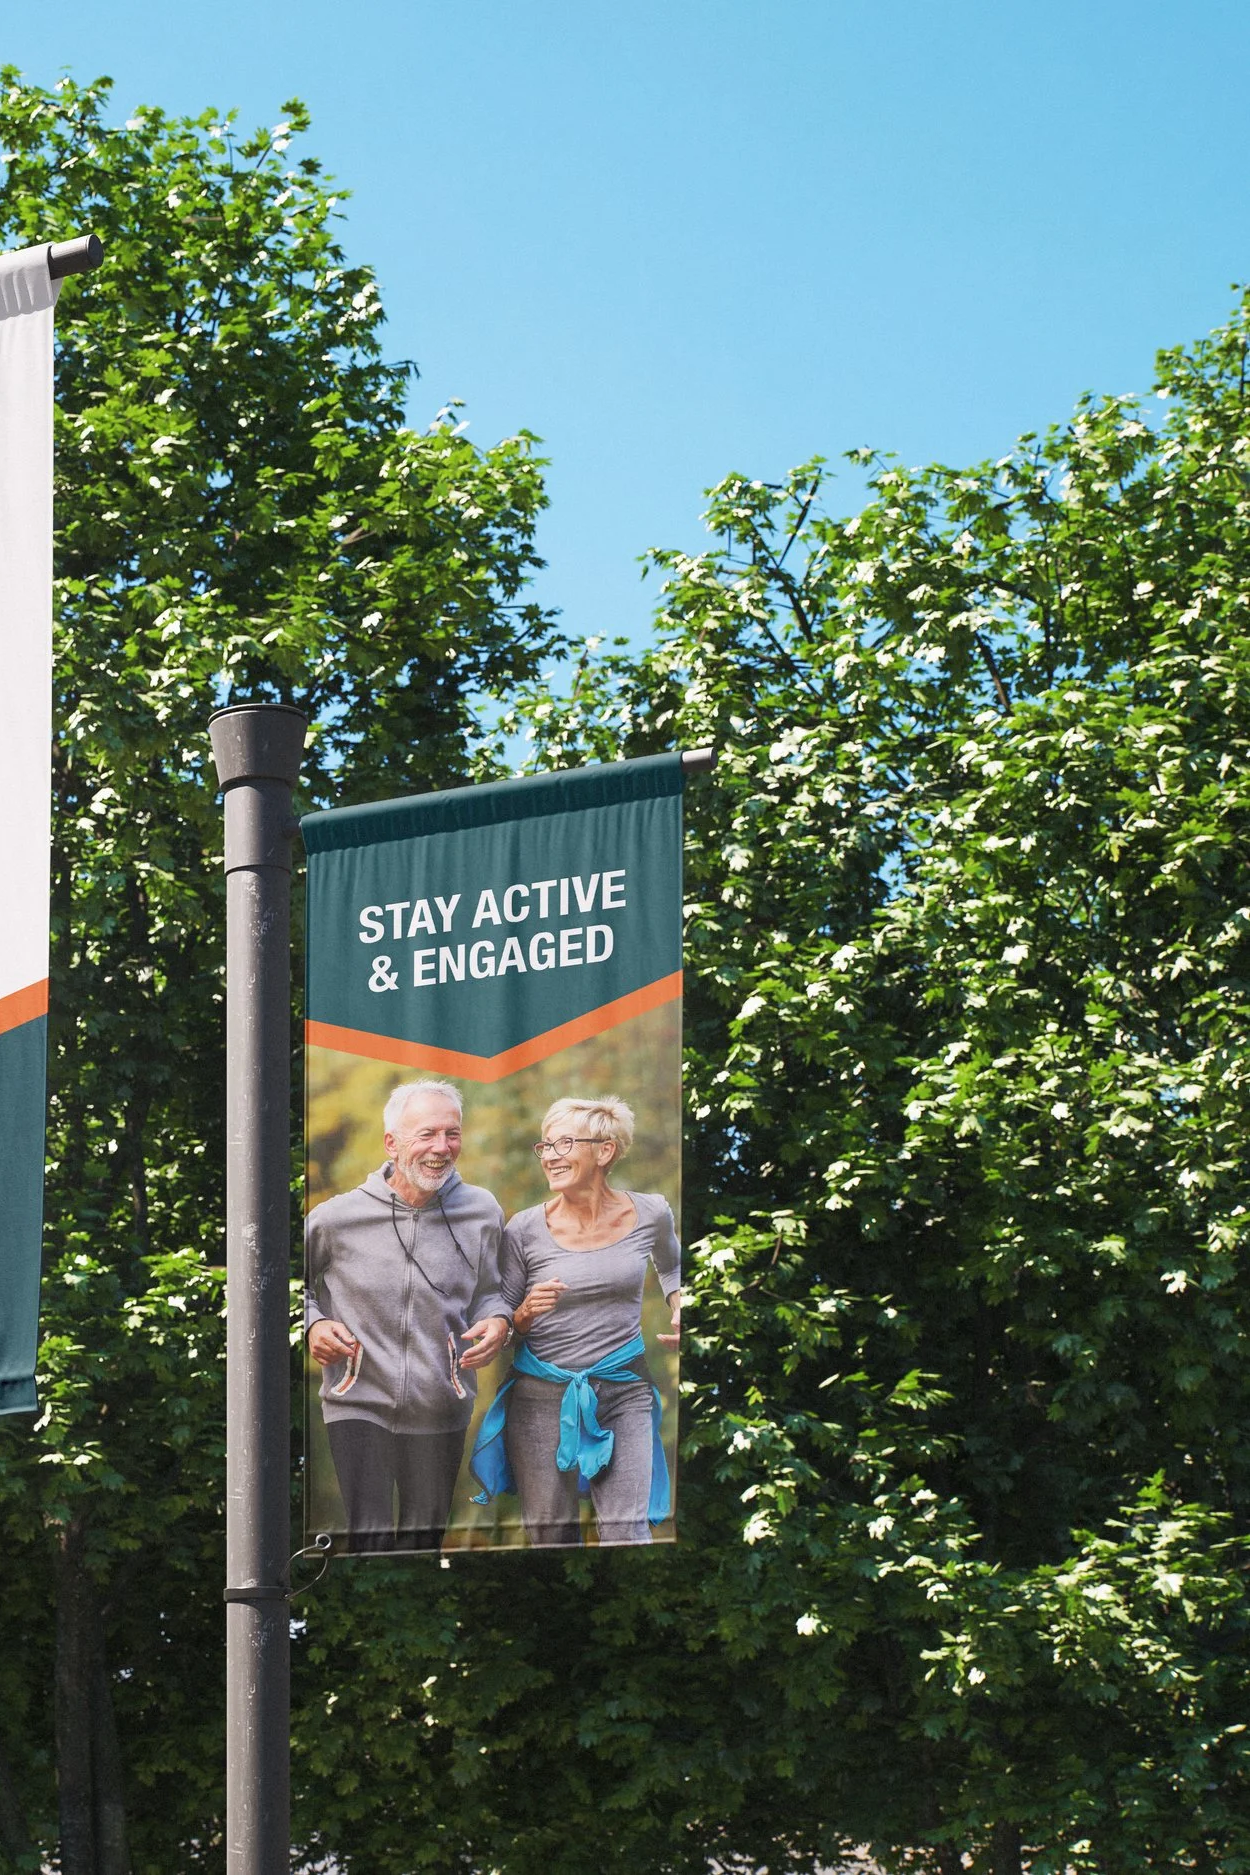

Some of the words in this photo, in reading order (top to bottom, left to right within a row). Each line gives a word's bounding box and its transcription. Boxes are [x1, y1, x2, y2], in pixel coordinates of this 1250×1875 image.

[358, 893, 462, 944] STAY
[471, 869, 627, 929] ACTIVE
[367, 955, 400, 993] &
[413, 924, 615, 988] ENGAGED
